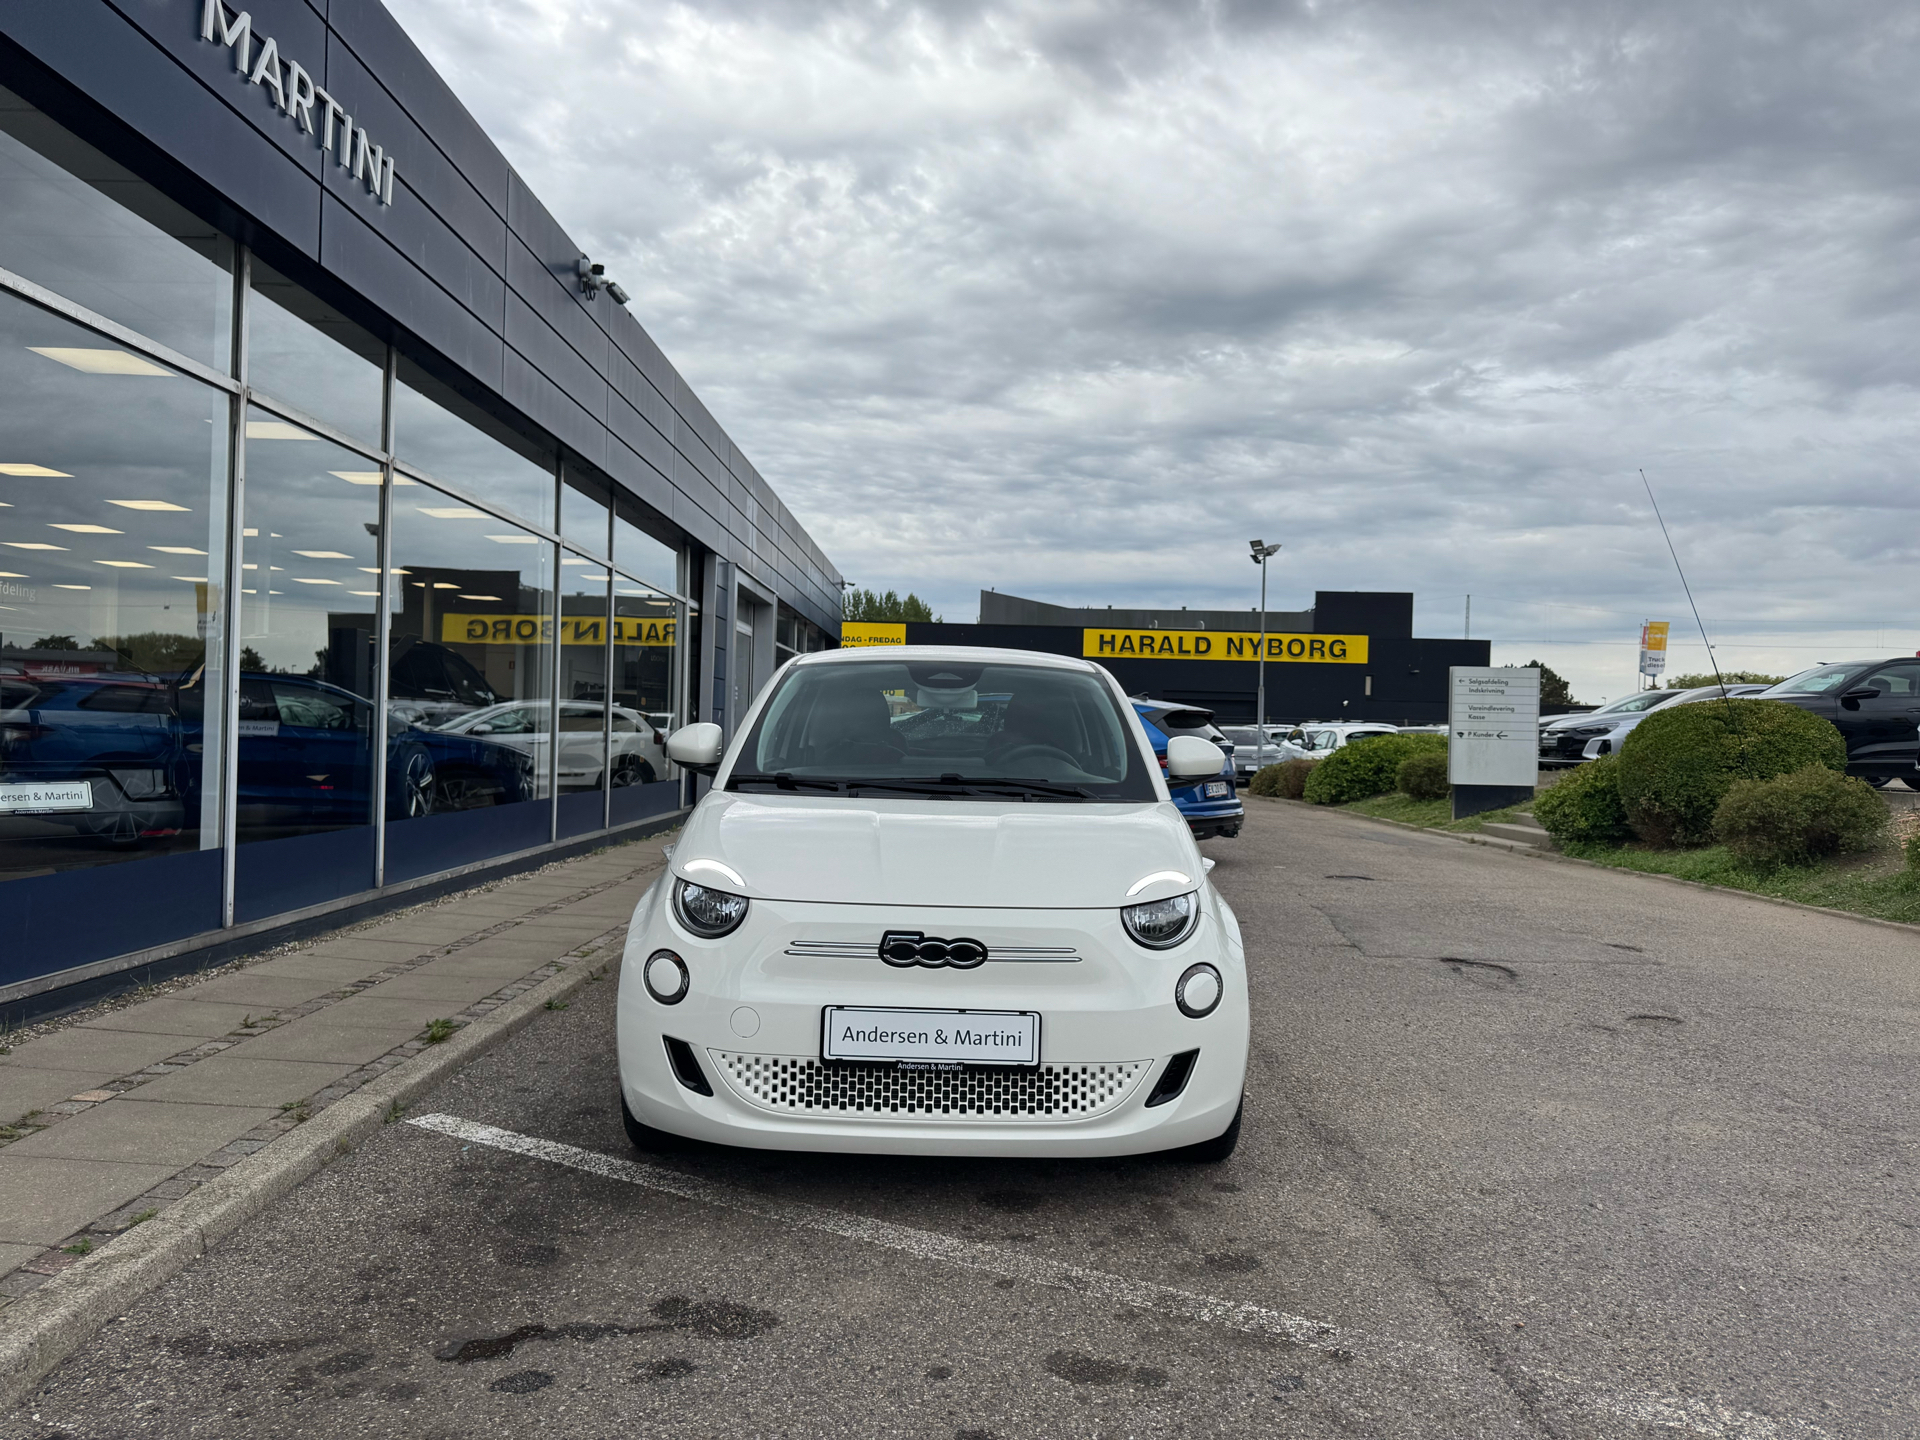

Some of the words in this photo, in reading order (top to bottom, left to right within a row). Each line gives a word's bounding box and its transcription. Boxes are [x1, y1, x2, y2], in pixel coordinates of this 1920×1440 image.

[200, 0, 394, 206] MARTINI
[868, 636, 902, 644] FREDAG
[1098, 633, 1212, 655] HARALD
[1226, 637, 1347, 659] NYBORG
[1468, 705, 1514, 713] Vareindlevering
[33, 791, 42, 801] &
[45, 791, 83, 801] Martini
[880, 931, 987, 968] 500
[842, 1026, 928, 1044] Andersen
[934, 1028, 948, 1045] &
[954, 1029, 1022, 1047] Martini
[897, 1062, 930, 1070] Andersen
[937, 1063, 964, 1071] Martini
